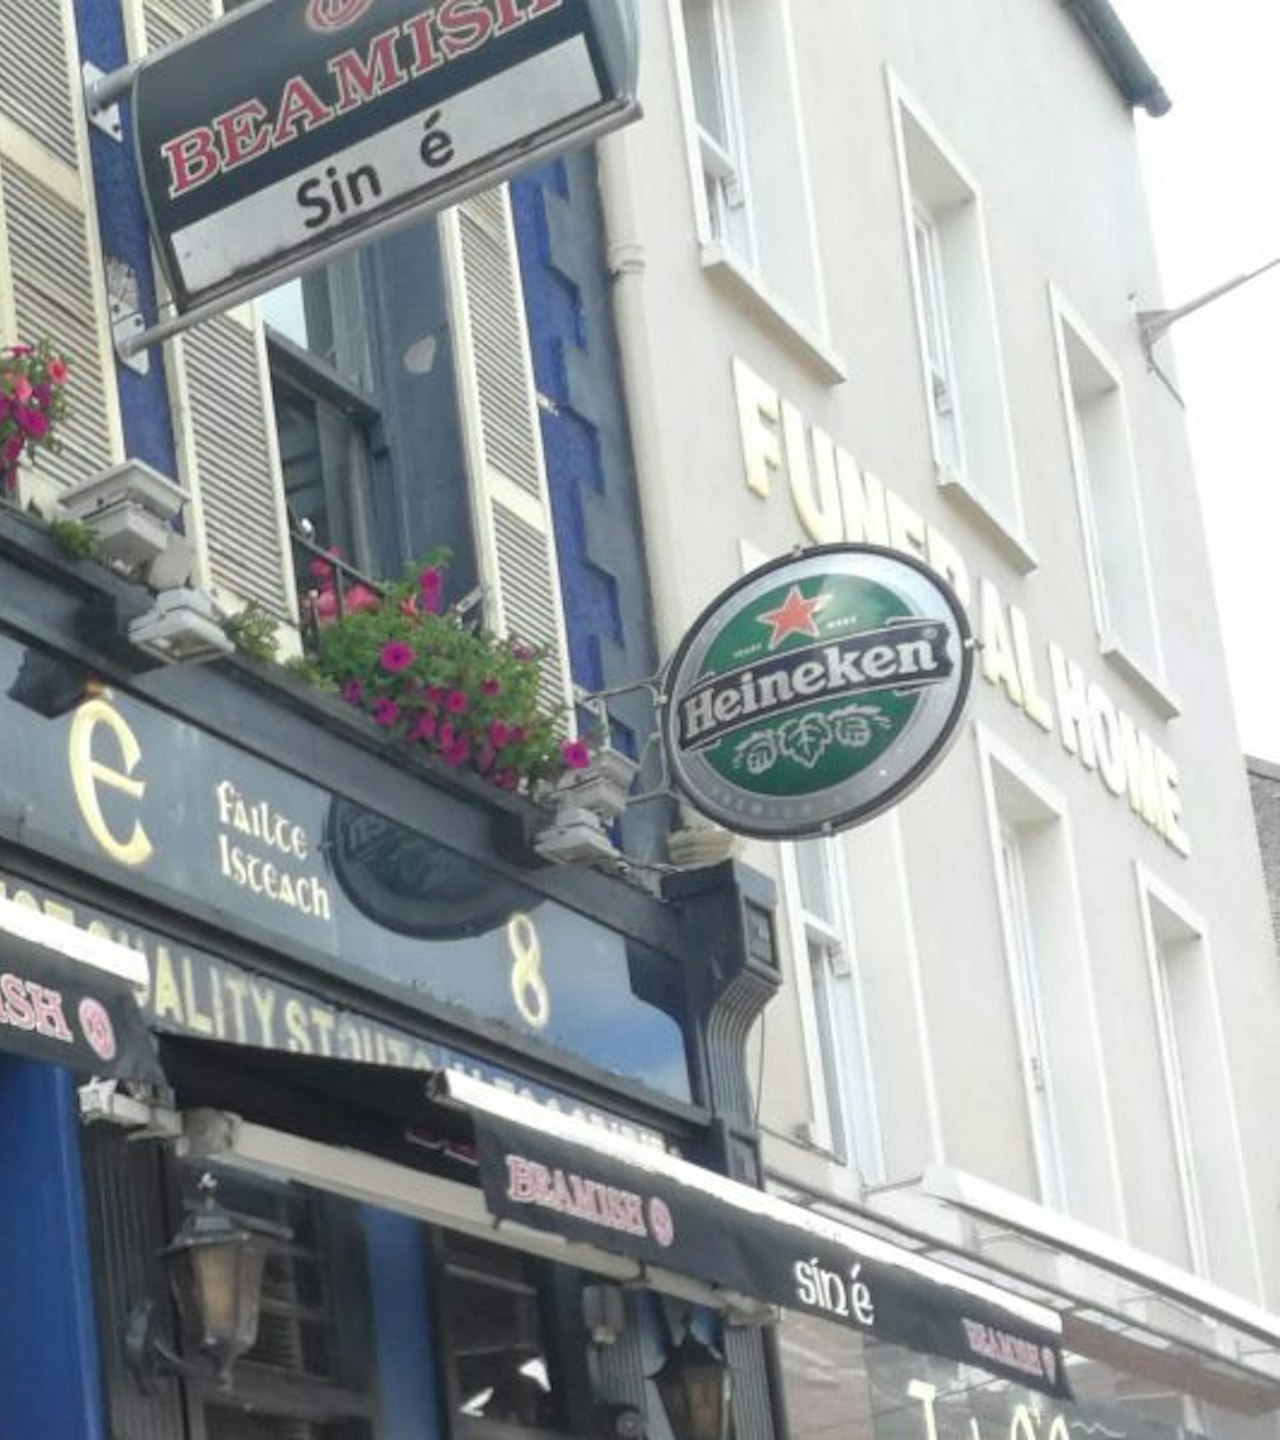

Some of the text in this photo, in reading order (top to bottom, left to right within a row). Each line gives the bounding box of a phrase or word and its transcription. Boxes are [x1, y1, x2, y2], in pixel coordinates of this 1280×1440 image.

[296, 110, 454, 229] Sin é
[732, 355, 1190, 858] FUNERAL HOME
[683, 637, 938, 738] Heineken
[508, 912, 551, 1029] 8
